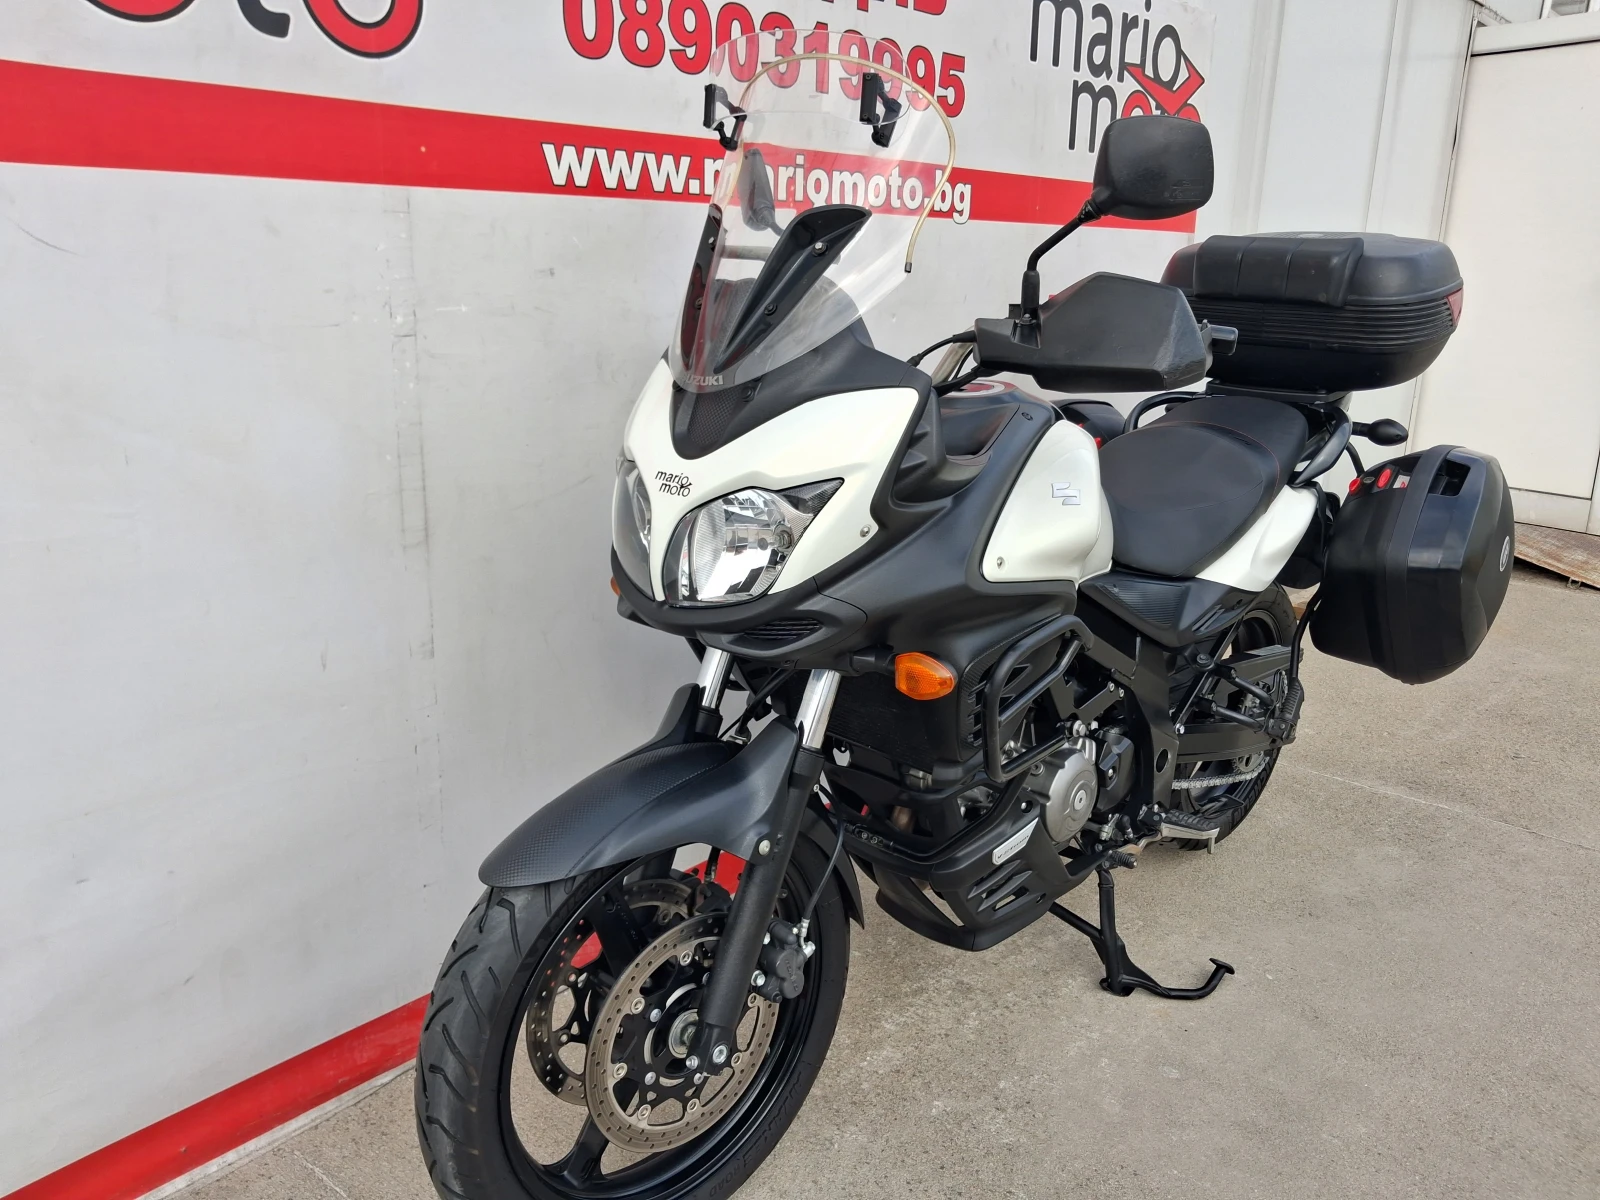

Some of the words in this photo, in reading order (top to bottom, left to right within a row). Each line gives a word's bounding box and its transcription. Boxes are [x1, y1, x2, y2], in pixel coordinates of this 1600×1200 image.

[563, 0, 966, 118] 0890319995
[1030, 0, 1182, 84] mario
[541, 142, 972, 224] www.mriomoto.bg
[682, 374, 724, 386] UZUKI
[655, 470, 690, 486] mario
[658, 482, 691, 498] moto
